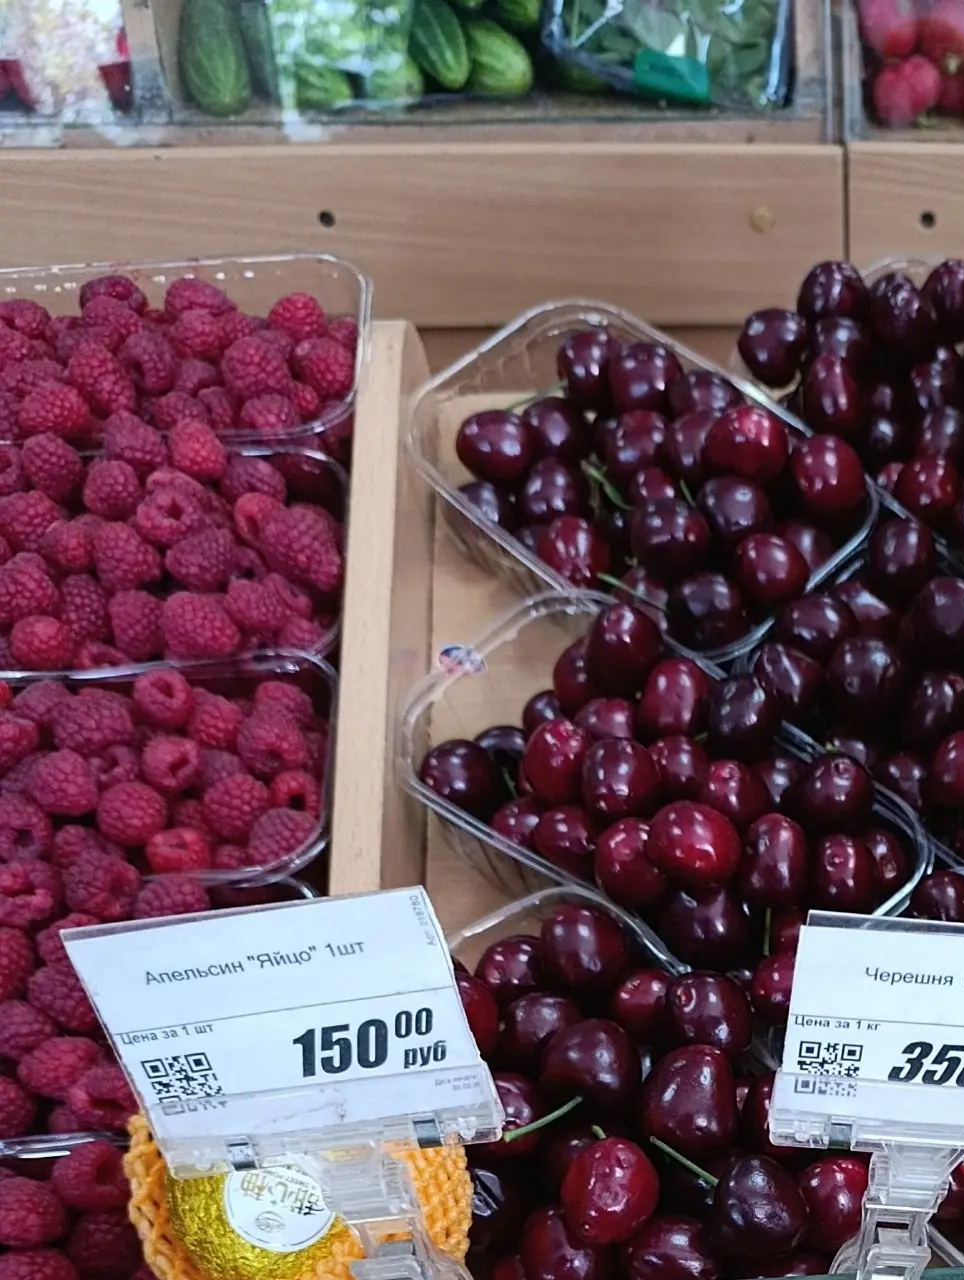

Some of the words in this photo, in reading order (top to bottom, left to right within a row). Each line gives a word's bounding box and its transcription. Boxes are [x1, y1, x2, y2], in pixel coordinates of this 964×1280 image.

[145, 958, 245, 986] Апельсин
[247, 945, 317, 971] "Яйцо"
[326, 940, 365, 958] 1шт
[865, 966, 954, 986] Черешня
[120, 1032, 159, 1045] Цена
[161, 1028, 179, 1039] за
[181, 1025, 190, 1036] 1
[194, 1023, 214, 1035] шт
[394, 1007, 434, 1039] 00
[795, 1015, 830, 1028] Цена
[834, 1020, 850, 1029] за
[855, 1020, 861, 1030] 1
[867, 1023, 882, 1031] кг
[293, 1018, 389, 1078] 150
[403, 1040, 447, 1069] руб
